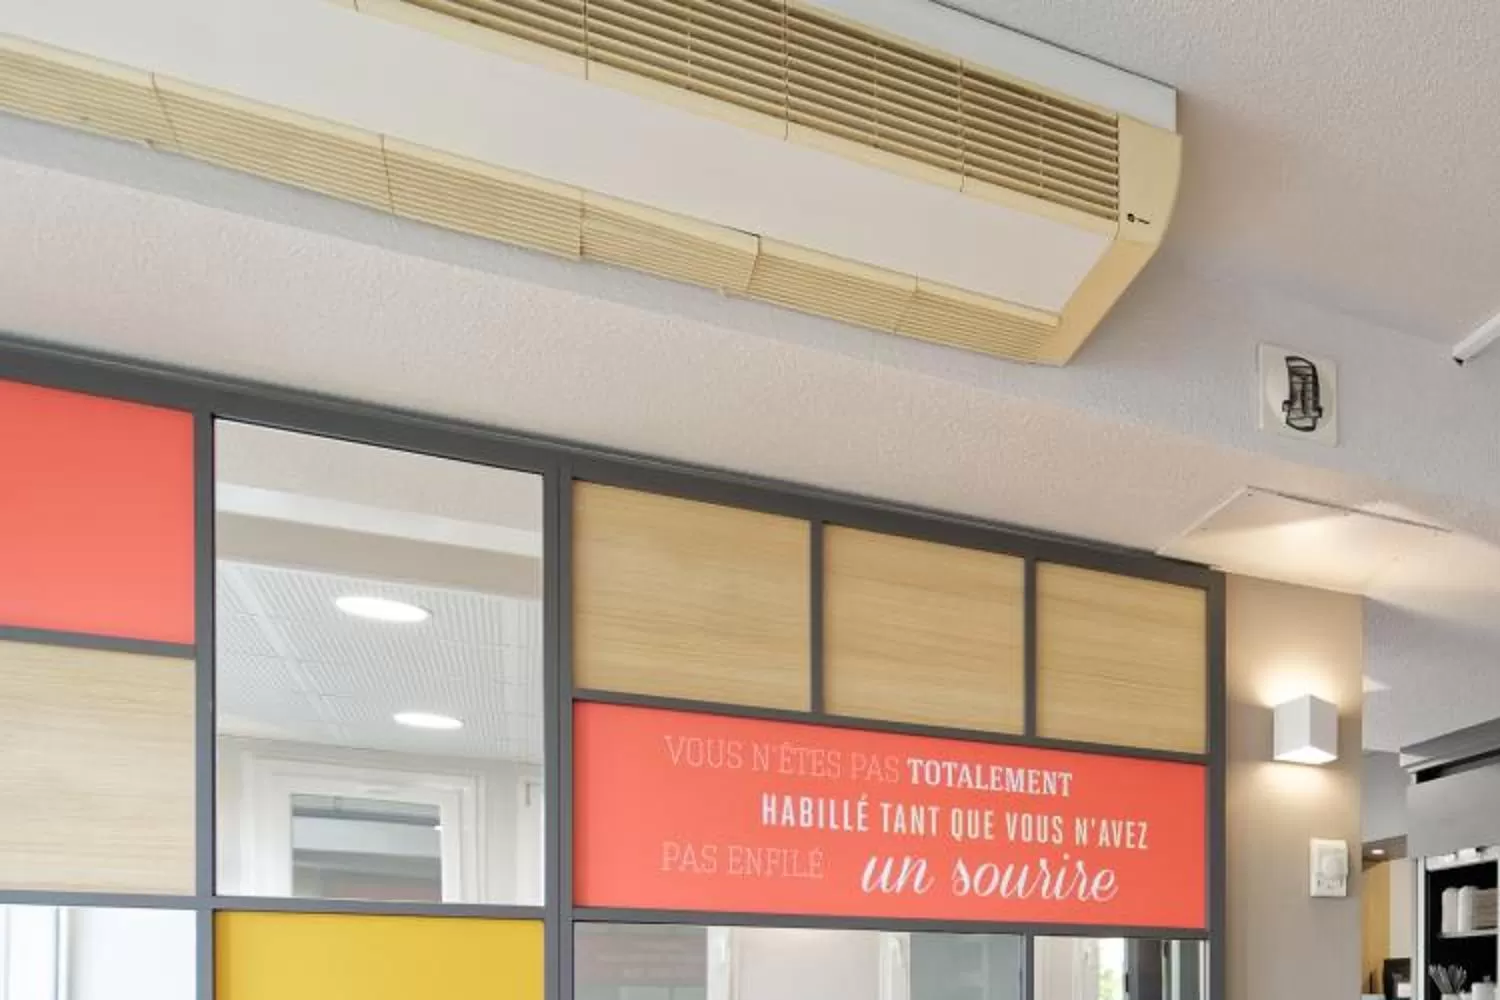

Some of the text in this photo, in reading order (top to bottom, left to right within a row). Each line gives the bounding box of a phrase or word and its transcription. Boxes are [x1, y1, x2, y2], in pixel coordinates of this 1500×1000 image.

[664, 735, 744, 769] VOUS
[850, 751, 900, 783] PAS
[907, 757, 1073, 797] TOTALEMENT
[761, 792, 1149, 849] HABILLÉ TANT QUE VOUS N'AVEZ
[660, 841, 1119, 902] PAS ENFILÉ un sourire
